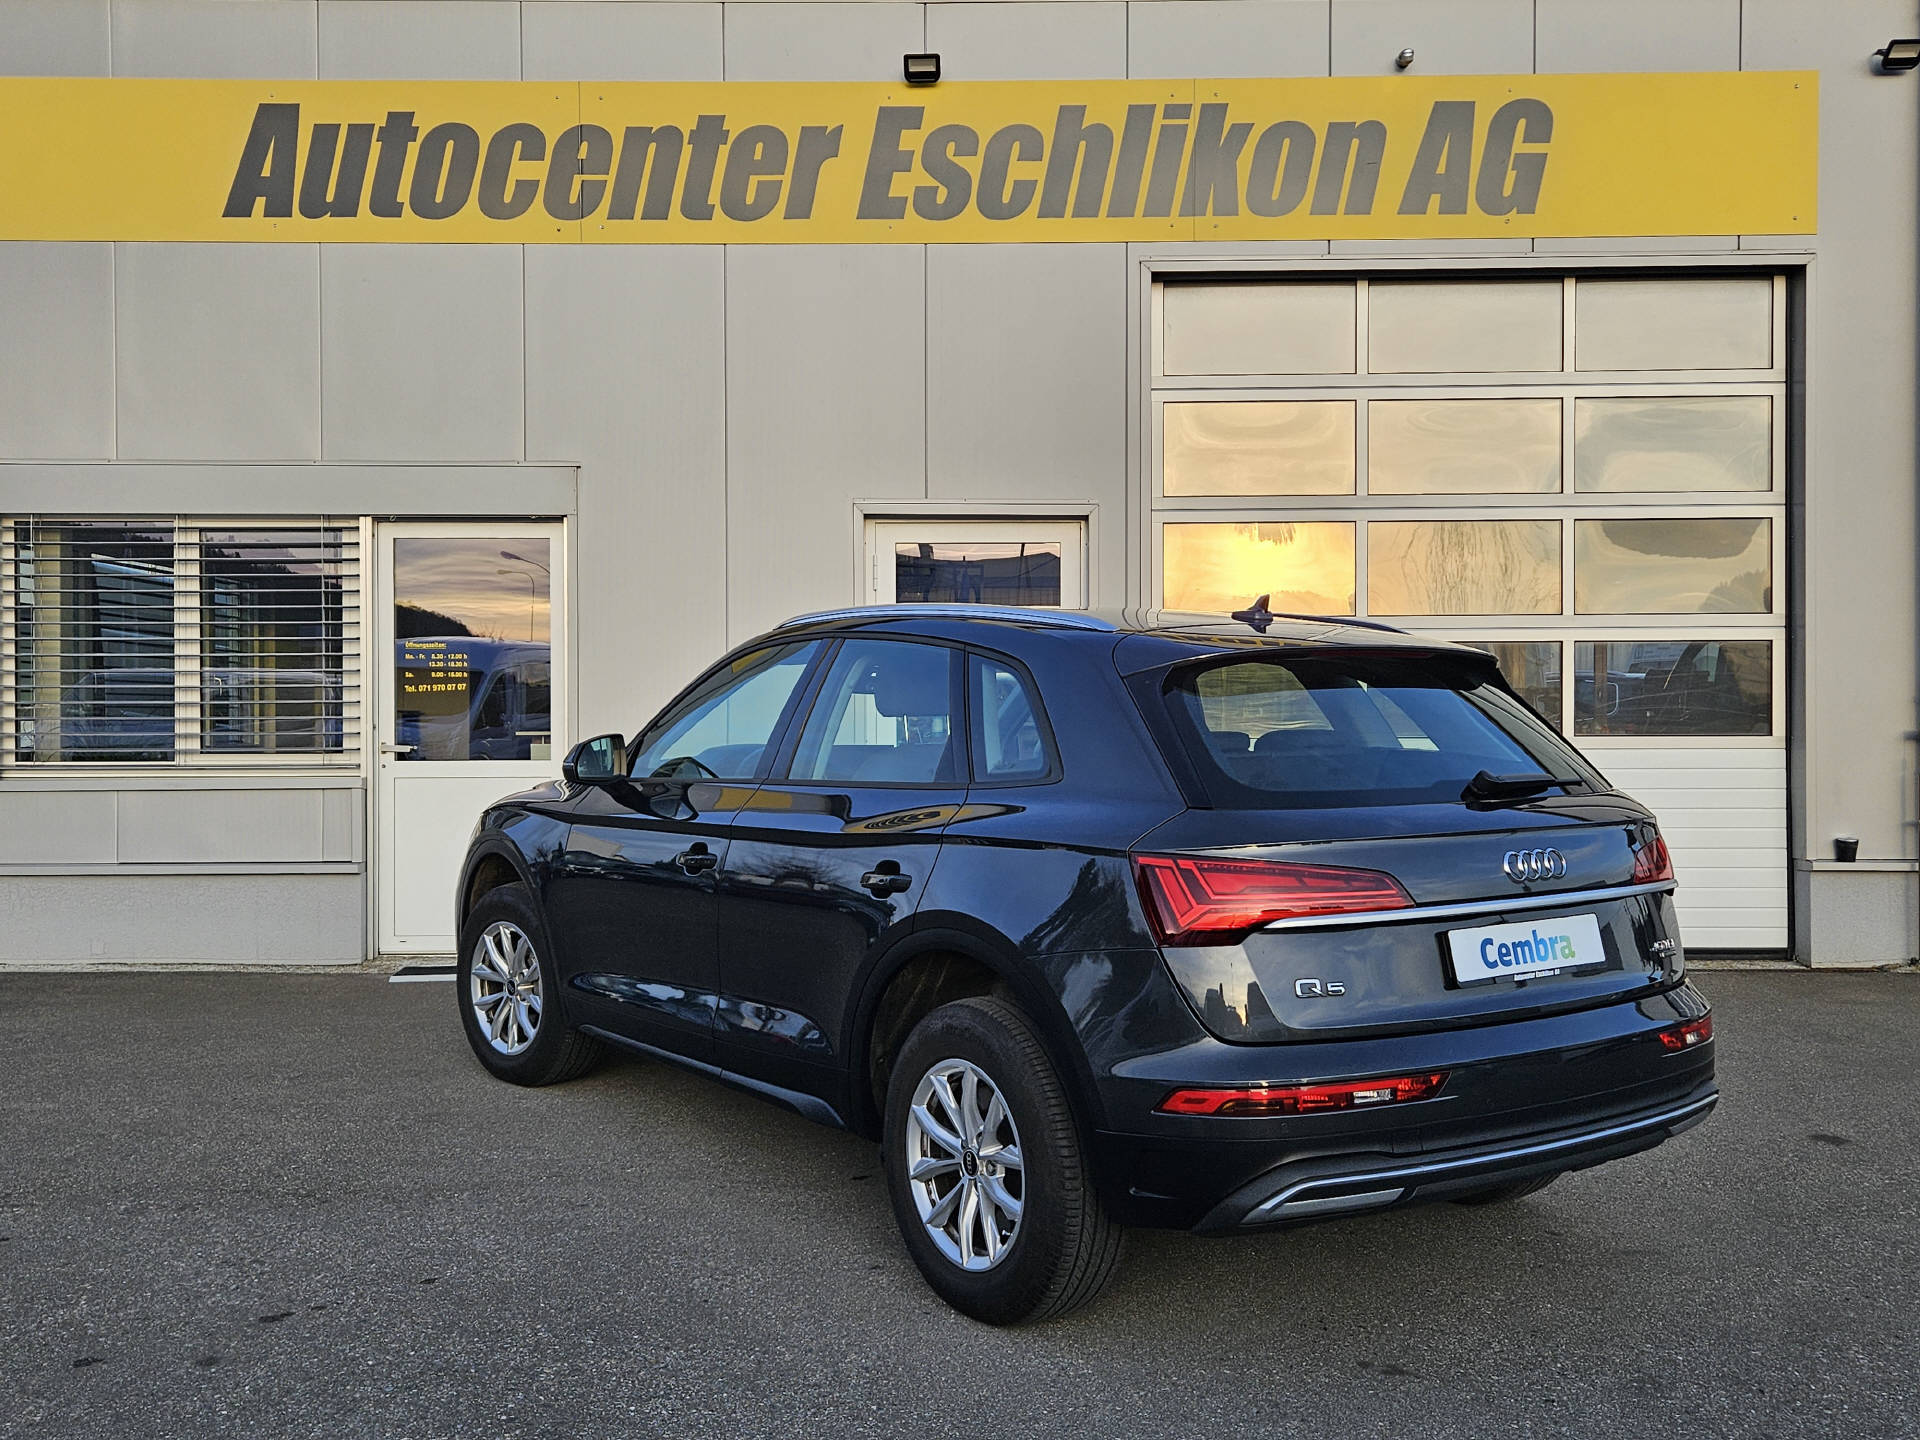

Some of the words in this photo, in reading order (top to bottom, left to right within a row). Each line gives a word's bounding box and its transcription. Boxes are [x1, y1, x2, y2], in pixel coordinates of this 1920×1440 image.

[221, 102, 844, 220] Autocenter
[856, 102, 1388, 221] Eschlikon
[1396, 97, 1554, 215] AG
[404, 684, 417, 693] Tel.
[418, 684, 431, 692] 071
[432, 683, 446, 692] 970
[447, 683, 456, 691] 07
[1480, 929, 1576, 970] Cembra
[1294, 977, 1346, 998] Q5
